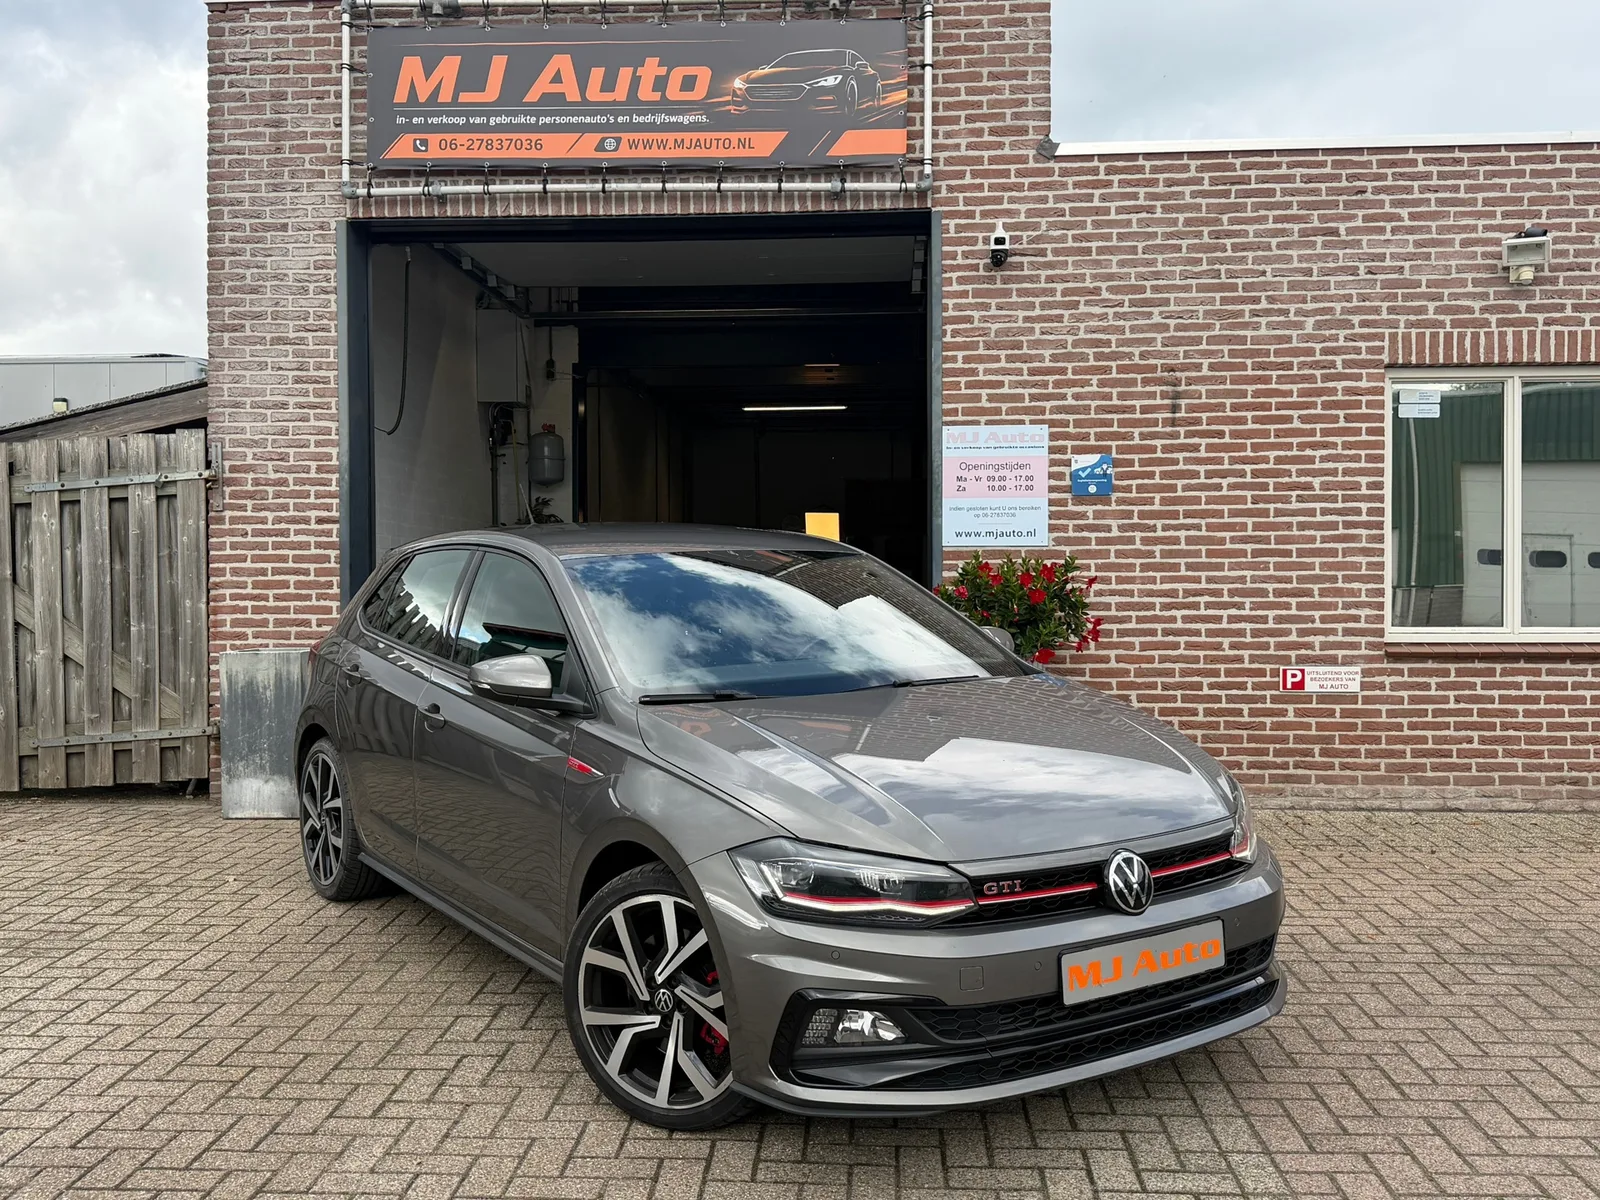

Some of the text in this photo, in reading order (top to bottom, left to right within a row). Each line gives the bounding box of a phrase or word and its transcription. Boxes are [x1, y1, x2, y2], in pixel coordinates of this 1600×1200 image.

[393, 54, 713, 103] MJ Auto
[396, 113, 710, 126] in- en verkoop van gebruikte personenauto's en bedrijfswagens.
[438, 138, 544, 151] 06-27837036
[627, 137, 755, 150] WWW.MJAUTO.NL
[946, 431, 1045, 445] MJ Auto
[959, 461, 1031, 473] Openingstijden
[954, 528, 1037, 540] www.mjauto.nl
[1286, 669, 1303, 689] P
[983, 879, 1022, 896] GTI
[1067, 938, 1221, 992] MJ Auto
